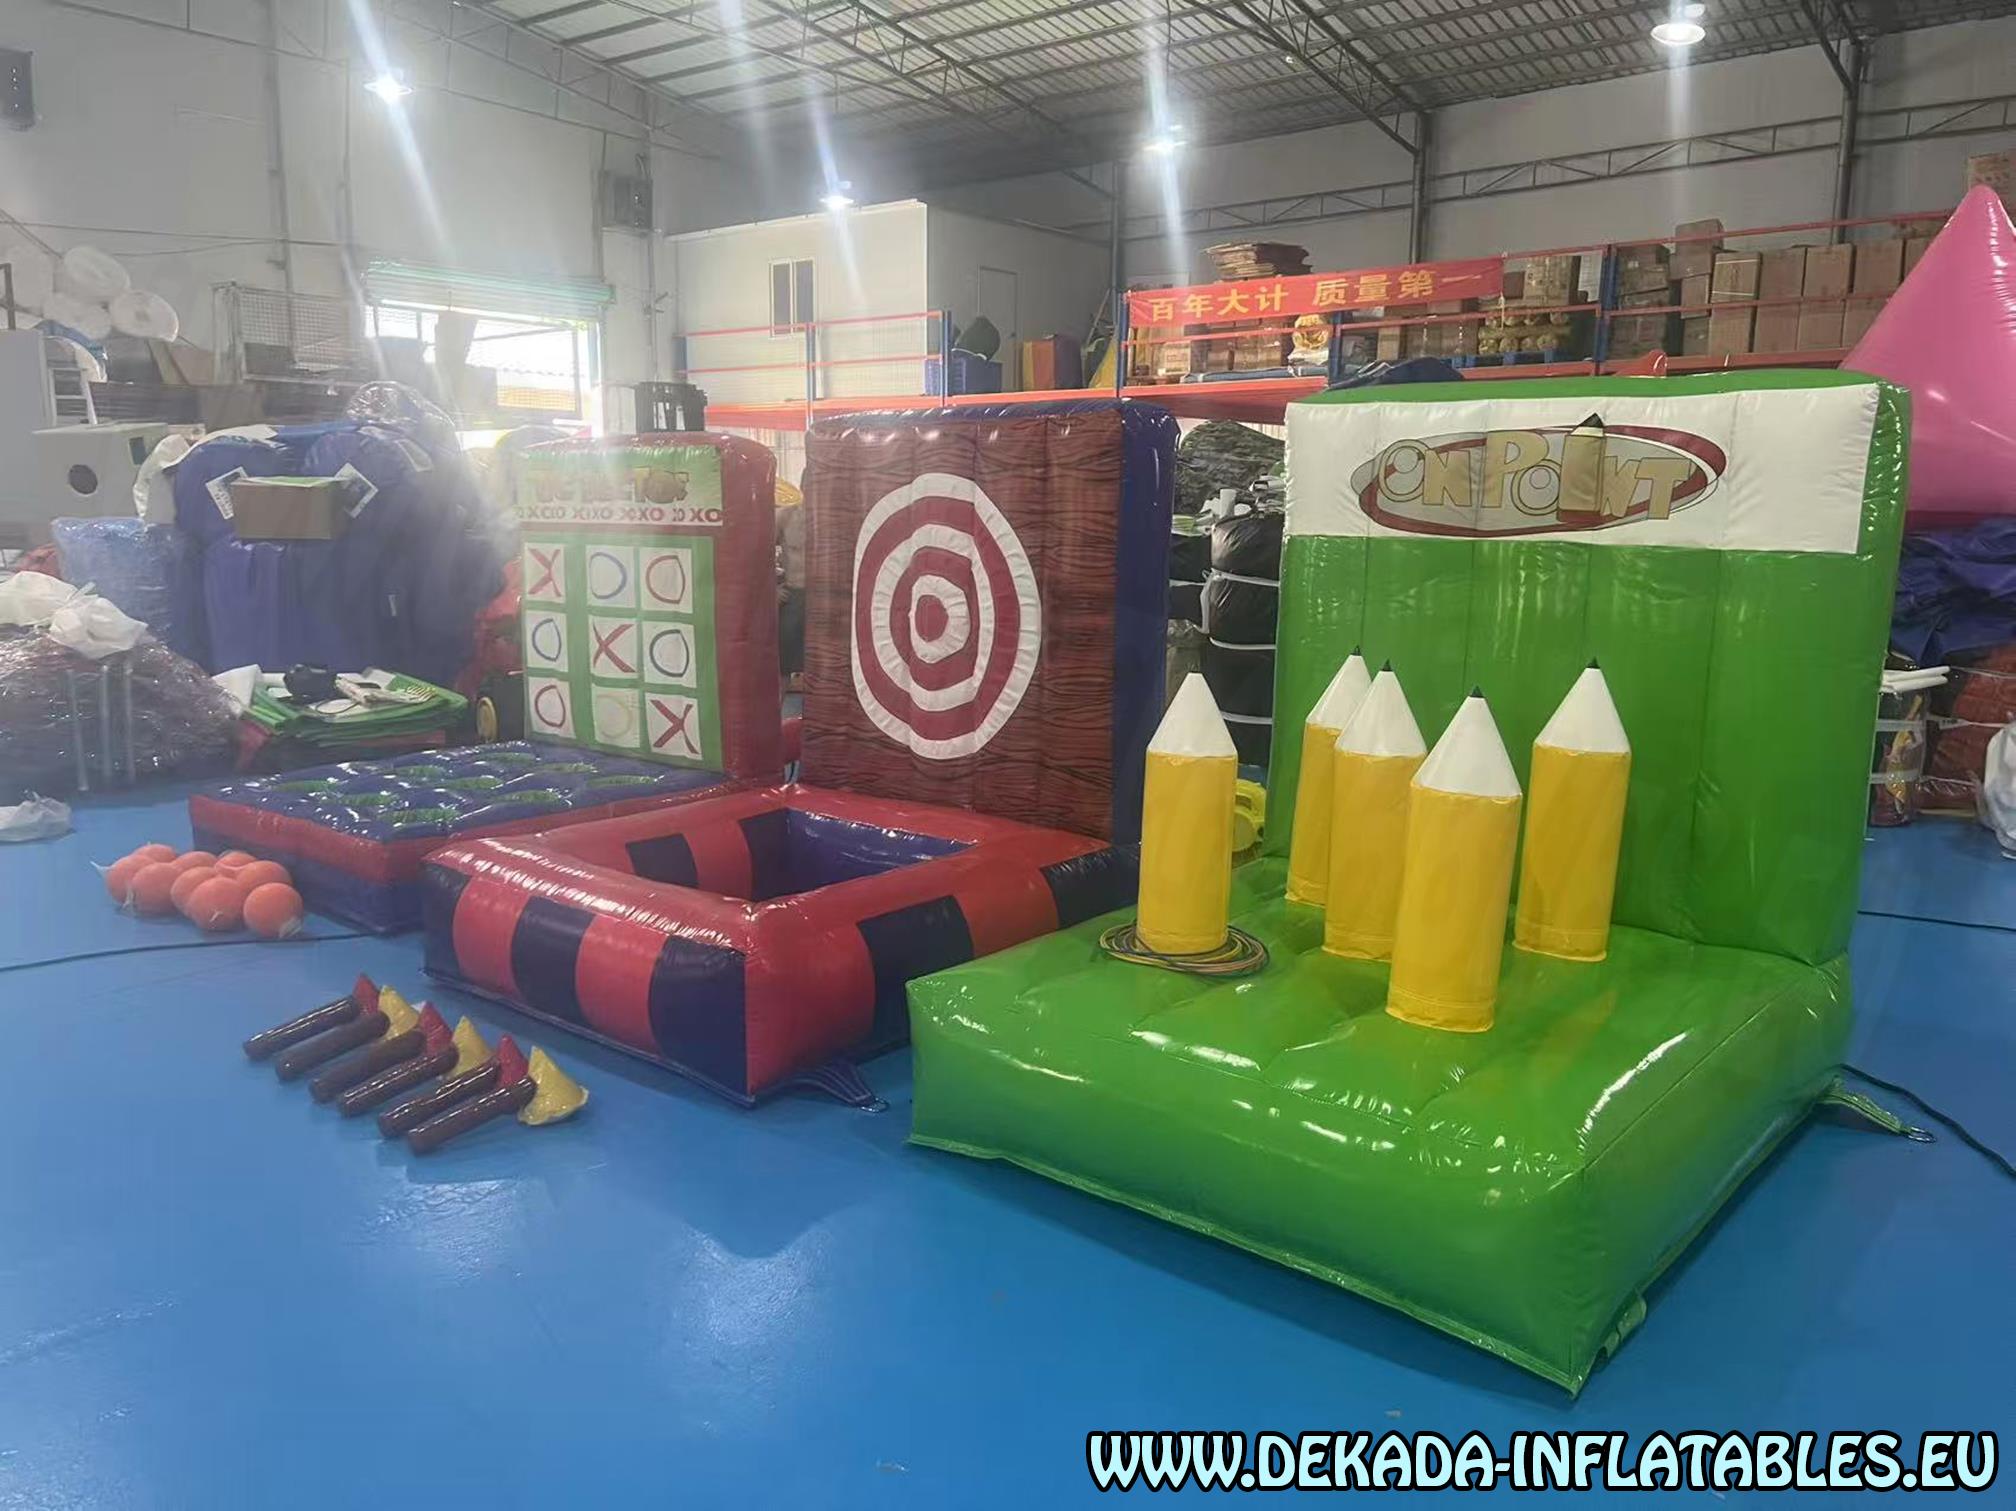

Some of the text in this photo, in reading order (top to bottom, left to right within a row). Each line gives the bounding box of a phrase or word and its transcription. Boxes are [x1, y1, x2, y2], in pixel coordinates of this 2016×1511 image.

[1148, 270, 1482, 322] 百年大计 质量第一
[1378, 438, 1472, 507] ON
